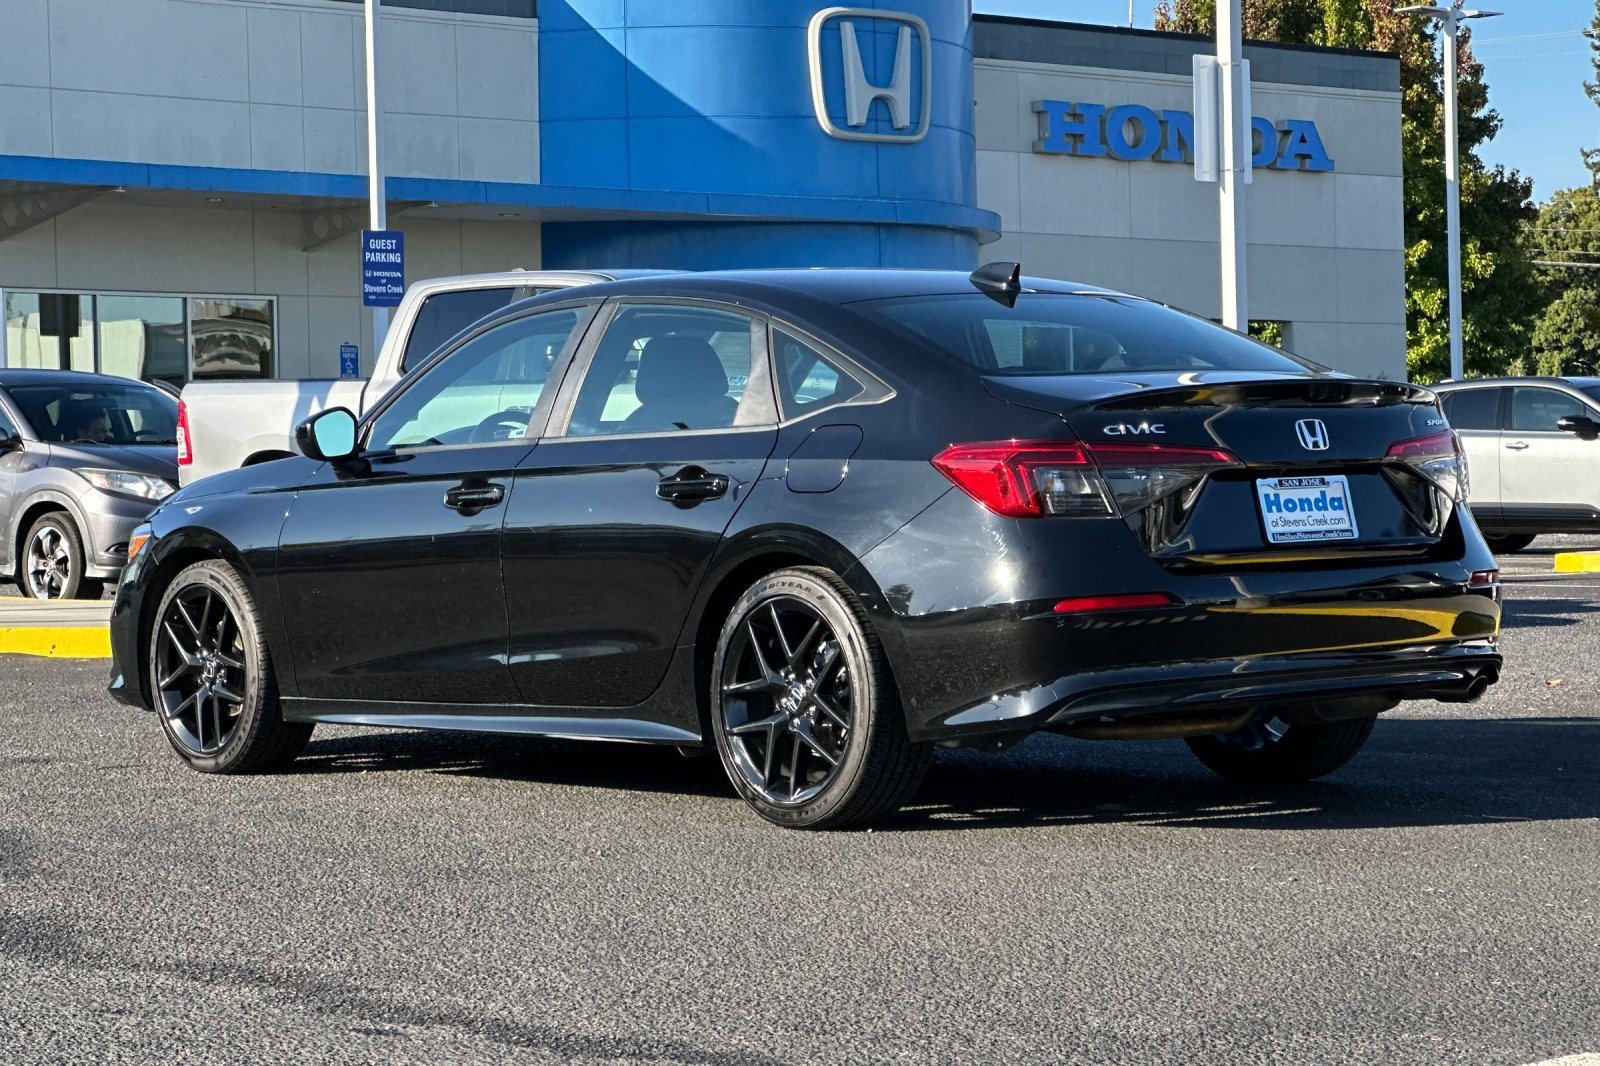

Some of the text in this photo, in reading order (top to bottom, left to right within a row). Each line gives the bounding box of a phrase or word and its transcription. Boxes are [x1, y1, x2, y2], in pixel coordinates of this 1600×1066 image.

[369, 239, 396, 249] GUEST
[365, 252, 401, 263] PARKING
[364, 283, 403, 294] Stevens Creek
[1426, 418, 1445, 426] SPOR
[1103, 423, 1166, 435] CIVIC
[1282, 478, 1323, 487] SAN JOSE
[1264, 490, 1345, 513] Honda
